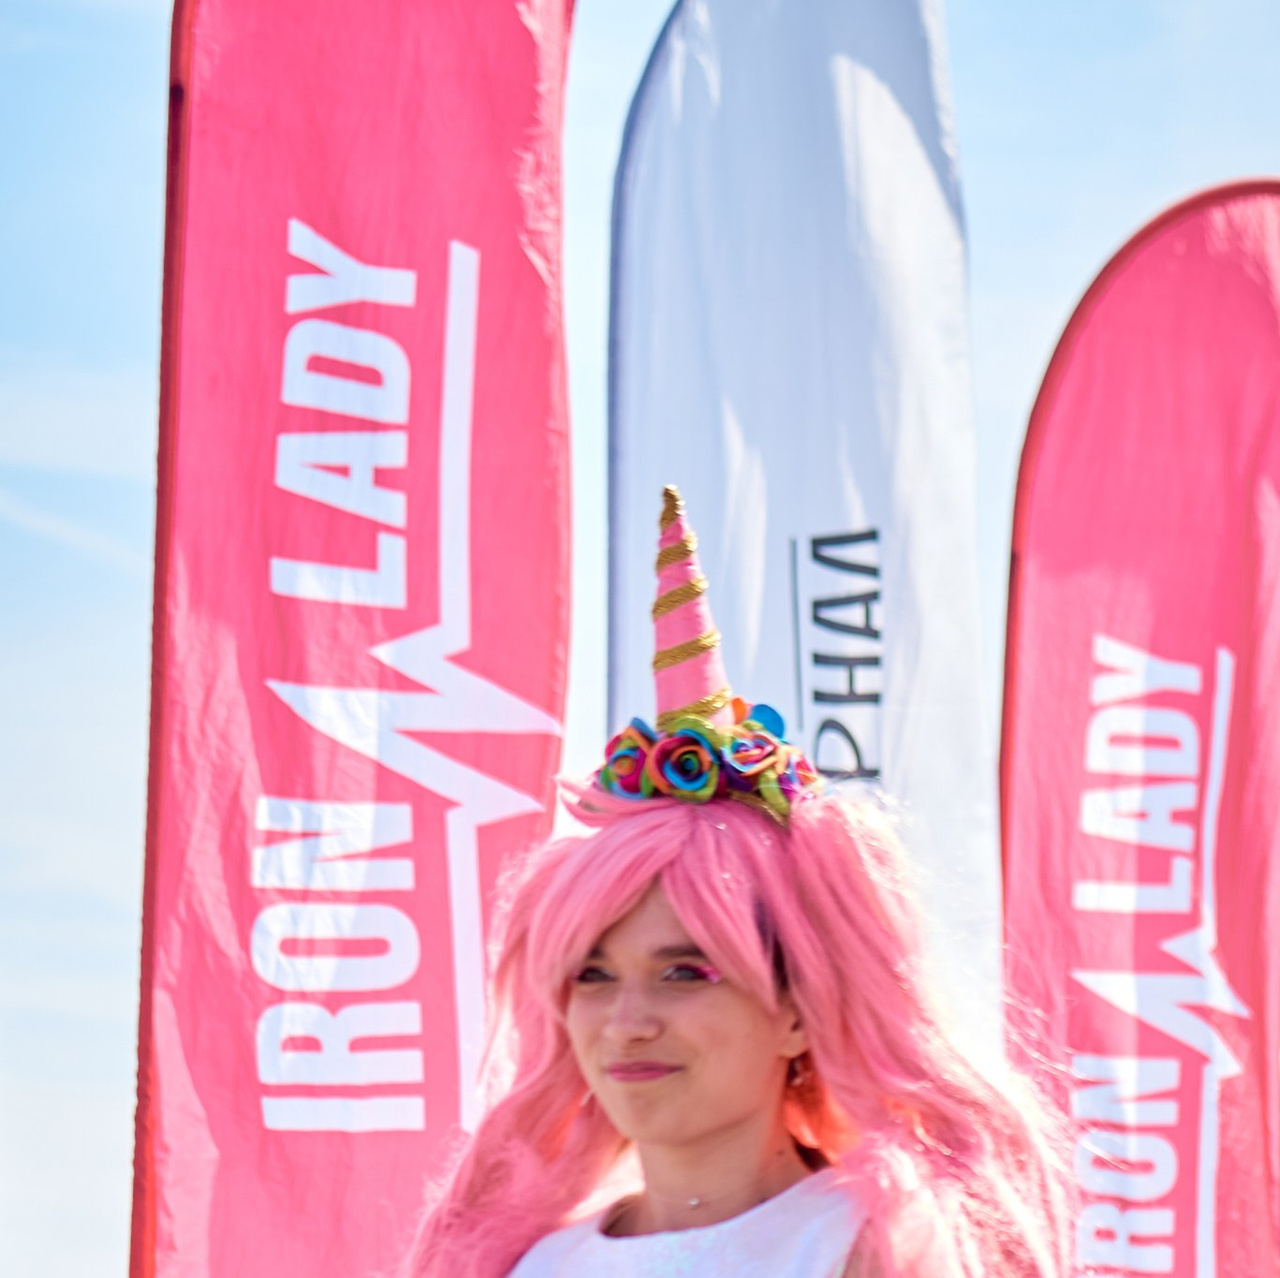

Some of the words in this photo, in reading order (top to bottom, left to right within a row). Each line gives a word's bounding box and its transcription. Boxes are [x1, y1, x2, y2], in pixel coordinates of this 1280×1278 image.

[269, 217, 417, 611] LADY
[1073, 633, 1202, 913] LADY
[250, 794, 425, 1134] IRON
